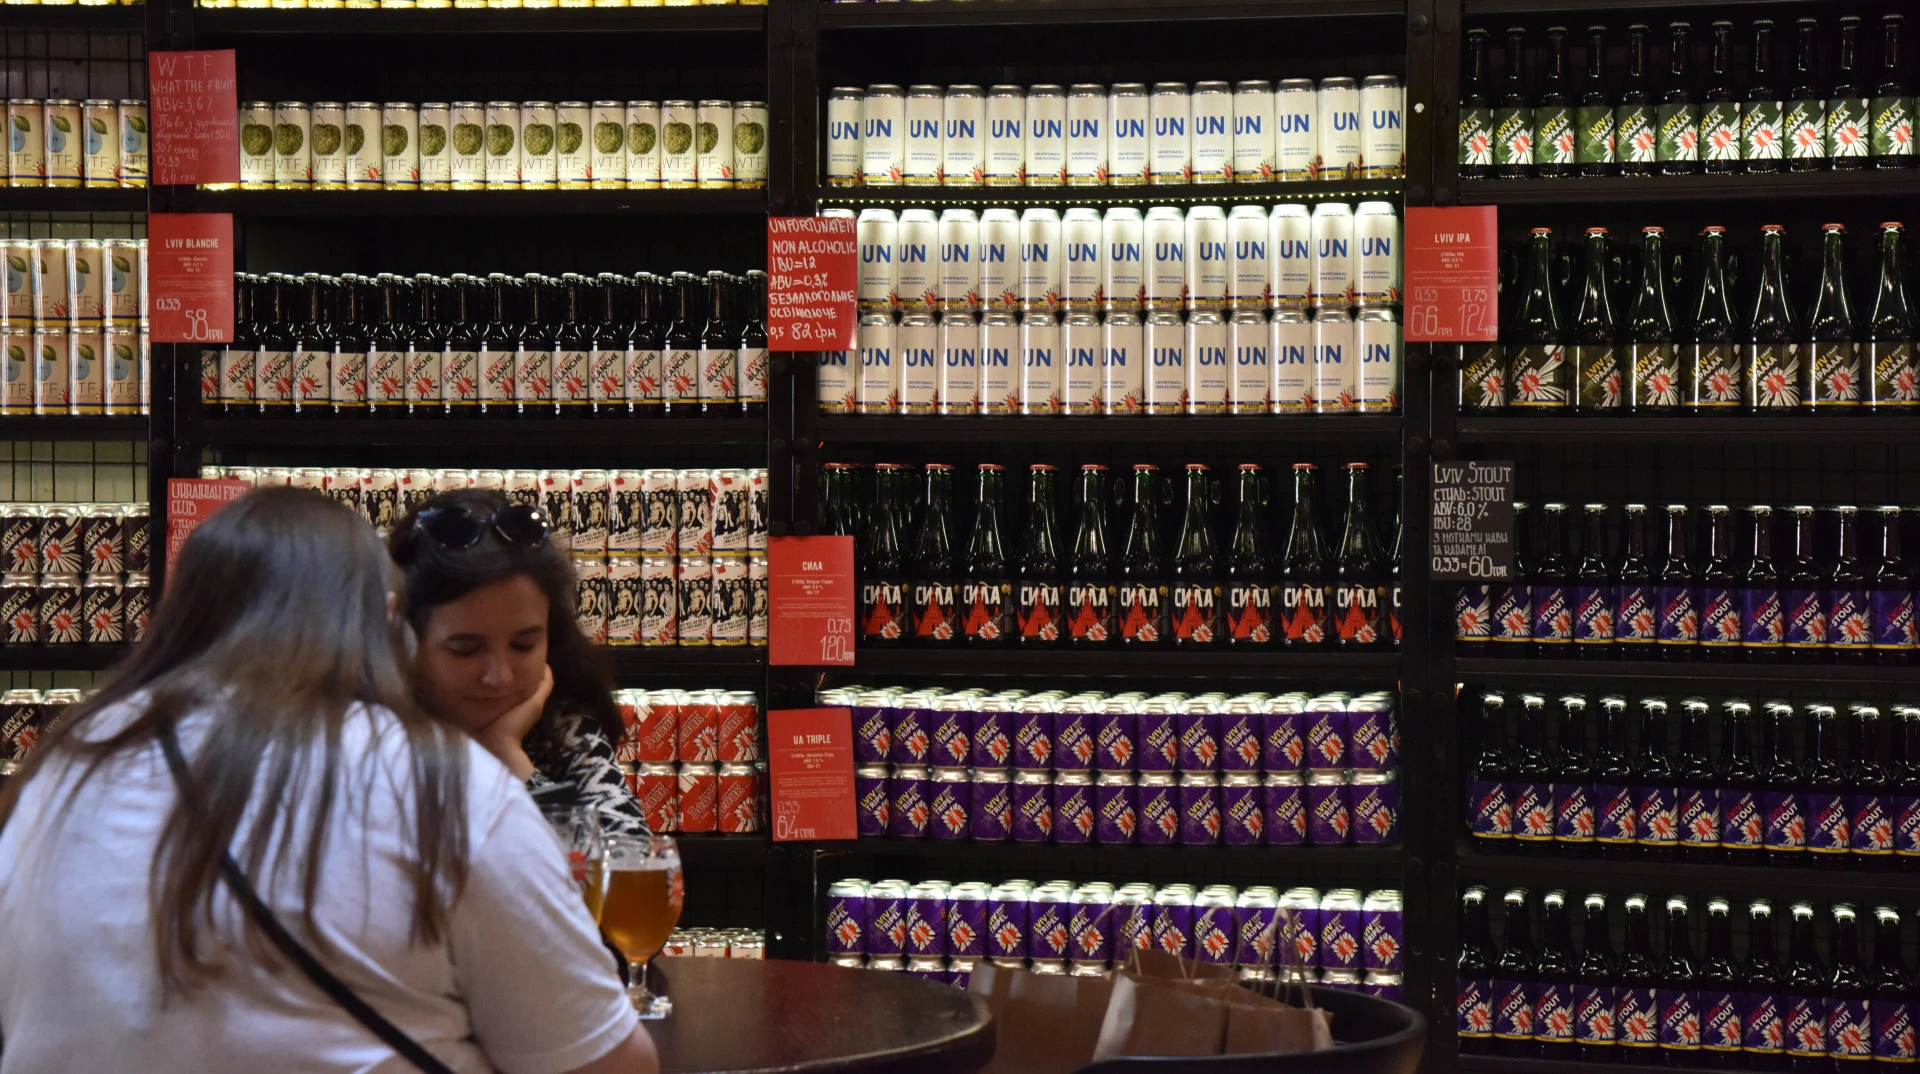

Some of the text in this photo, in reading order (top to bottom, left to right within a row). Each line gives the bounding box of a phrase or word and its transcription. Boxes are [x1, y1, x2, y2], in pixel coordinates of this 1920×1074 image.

[151, 79, 181, 95] WHAT
[184, 79, 203, 93] THE
[1155, 118, 1184, 136] UN
[1195, 117, 1225, 135] UN
[1235, 116, 1261, 135] UN
[1280, 115, 1309, 133] UN
[1333, 113, 1359, 131] UN
[1373, 111, 1400, 129] UN
[1540, 118, 1556, 137] LVIV
[1875, 108, 1892, 129] LVIV
[832, 123, 858, 139] UN
[865, 120, 892, 137] UN
[910, 120, 939, 138] UN
[947, 120, 975, 138] UN
[992, 120, 1020, 138] UN
[1033, 120, 1062, 138] UN
[1070, 120, 1099, 138] UN
[1115, 119, 1144, 138] UN
[165, 238, 219, 249] LVIV BLANCHE
[1362, 238, 1390, 256] UN
[1434, 233, 1471, 244] LVIV IPA
[863, 245, 891, 262] UN
[900, 245, 926, 262] UN
[942, 244, 969, 262] UN
[1022, 244, 1048, 262] UN
[1069, 244, 1096, 261] UN
[1112, 244, 1140, 261] UN
[1156, 243, 1183, 261] UN
[1237, 242, 1265, 259] UN
[1281, 241, 1309, 259] UN
[156, 298, 181, 311] 0,33
[1462, 288, 1488, 303] 0,75
[791, 322, 813, 340] 82
[907, 350, 934, 366] UN
[947, 350, 975, 366] UN
[981, 350, 1008, 366] UN
[1240, 349, 1266, 364] UN
[1874, 355, 1893, 376] LVIV
[517, 361, 531, 378] LVIV
[520, 353, 548, 383] BLANCHE
[702, 361, 718, 378] LVIV
[707, 352, 735, 383] BLANCHE
[171, 482, 222, 500] UKRAINIAN
[171, 500, 197, 515] CLUB
[4, 520, 34, 551] DARK ALE
[1433, 545, 1442, 556] ТА
[802, 561, 823, 571] СИЛА
[40, 599, 52, 616] LVIV
[43, 590, 71, 621] DARK ALE
[1540, 596, 1564, 623] STOUT
[1706, 599, 1732, 625] STOUT
[827, 618, 851, 634] 0,75
[793, 734, 831, 745] UA TRIPLE
[974, 723, 991, 741] LVIV
[979, 725, 1001, 746] TRIPEL
[1353, 723, 1370, 742] LVIV
[1359, 723, 1380, 746] TRIPEL
[1773, 803, 1798, 829] STOUT
[874, 909, 891, 928] LVIV
[880, 911, 901, 933] TRIPEL
[1752, 1004, 1777, 1031] STOUT
